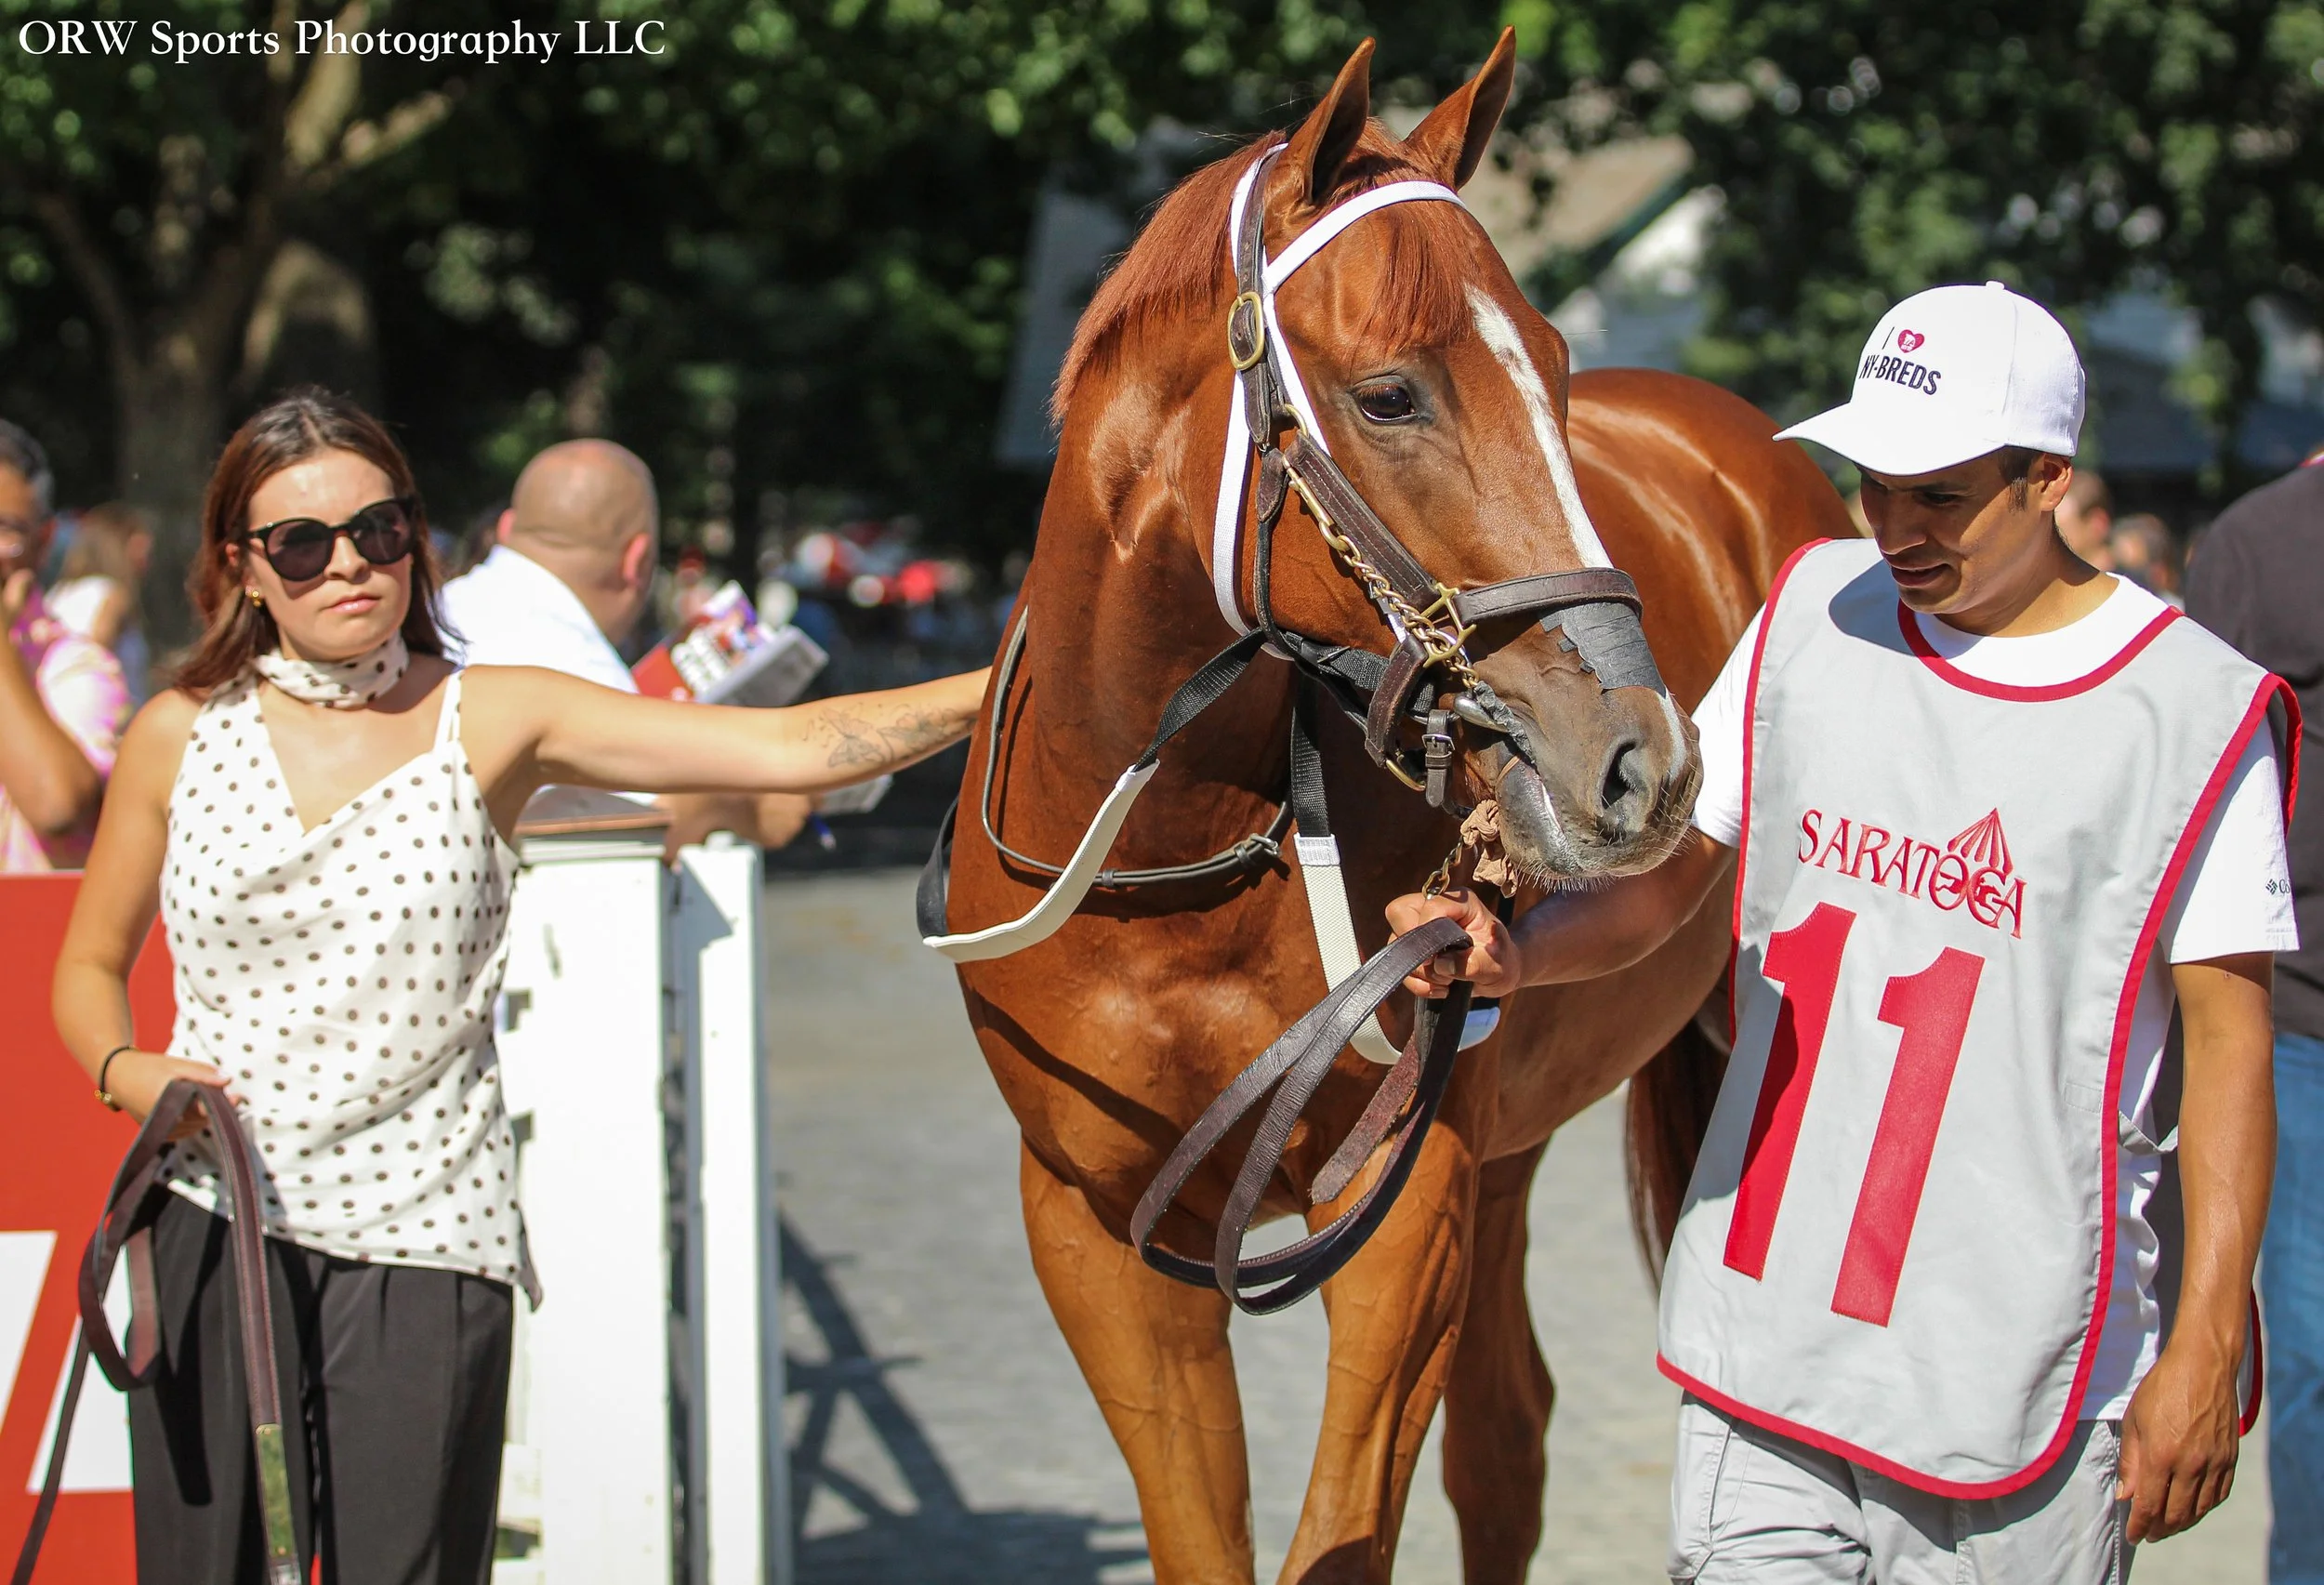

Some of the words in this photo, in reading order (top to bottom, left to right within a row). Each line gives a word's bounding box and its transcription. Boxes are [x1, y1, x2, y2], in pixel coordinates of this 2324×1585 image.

[1859, 354, 1941, 395] NY-BREDS
[1882, 326, 1895, 350] I
[1798, 807, 2027, 939] SARATOGA
[1723, 901, 1986, 1327] 11
